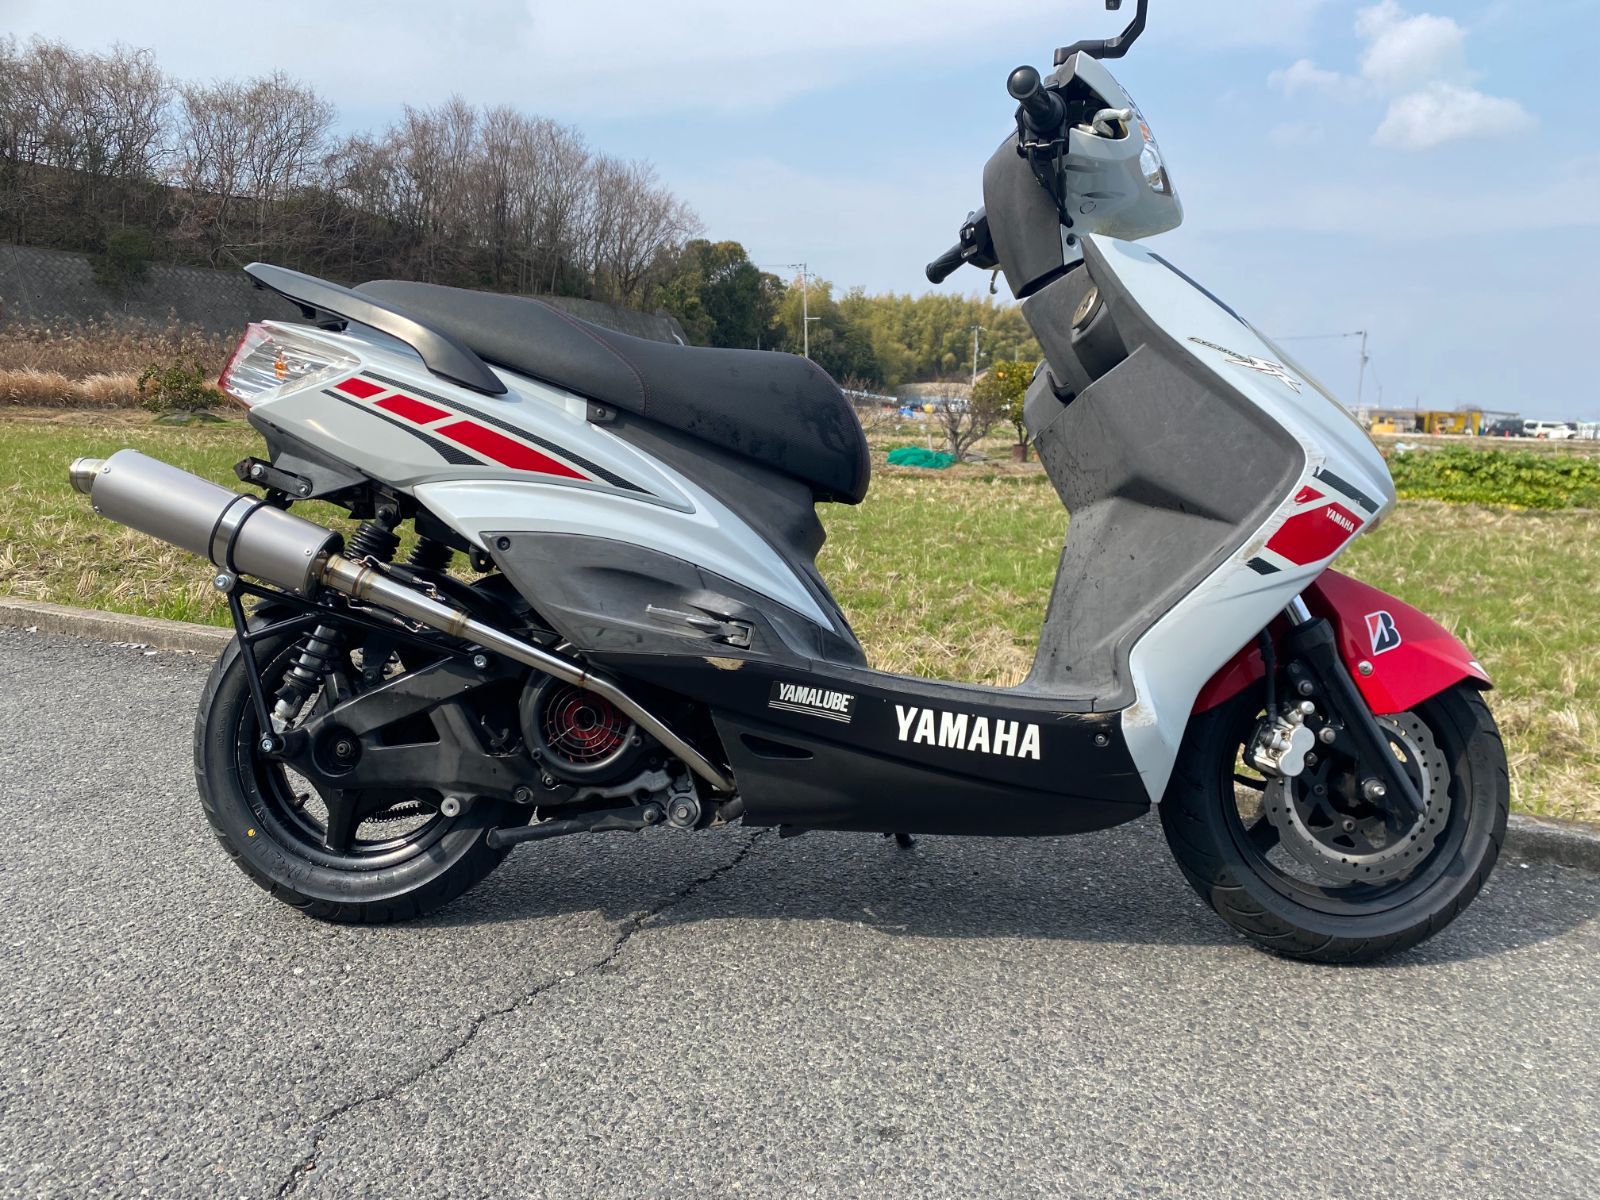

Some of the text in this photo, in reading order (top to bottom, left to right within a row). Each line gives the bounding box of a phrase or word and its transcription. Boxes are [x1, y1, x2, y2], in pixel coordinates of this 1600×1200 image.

[1326, 507, 1354, 532] YAMAHA
[779, 683, 849, 713] YAMALUBE
[895, 705, 1040, 760] YAMAHA
